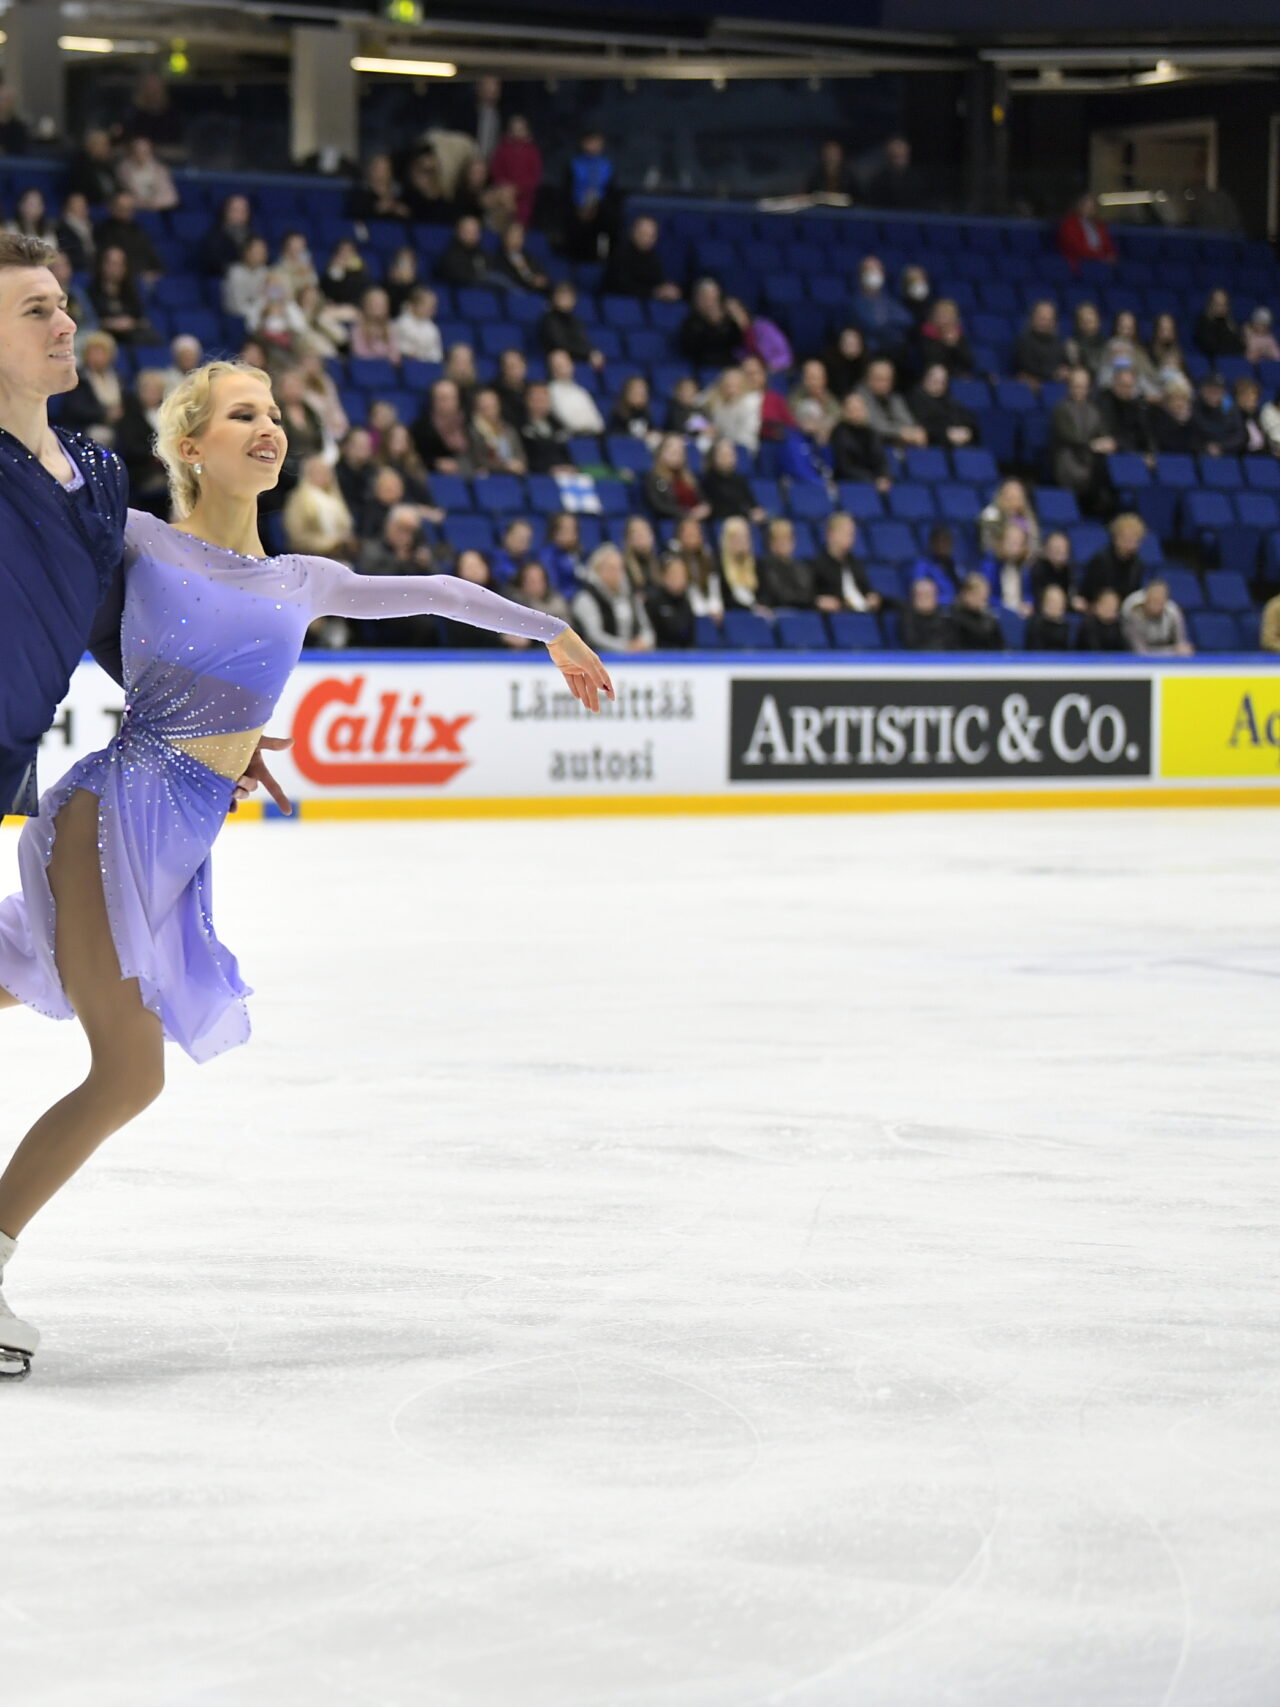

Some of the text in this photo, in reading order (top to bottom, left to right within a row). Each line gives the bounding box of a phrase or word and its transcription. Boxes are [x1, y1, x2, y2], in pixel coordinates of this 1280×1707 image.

[290, 675, 476, 786] Calix
[549, 739, 654, 780] autosi
[742, 693, 990, 764] ARTISTIC
[996, 692, 1046, 764] &
